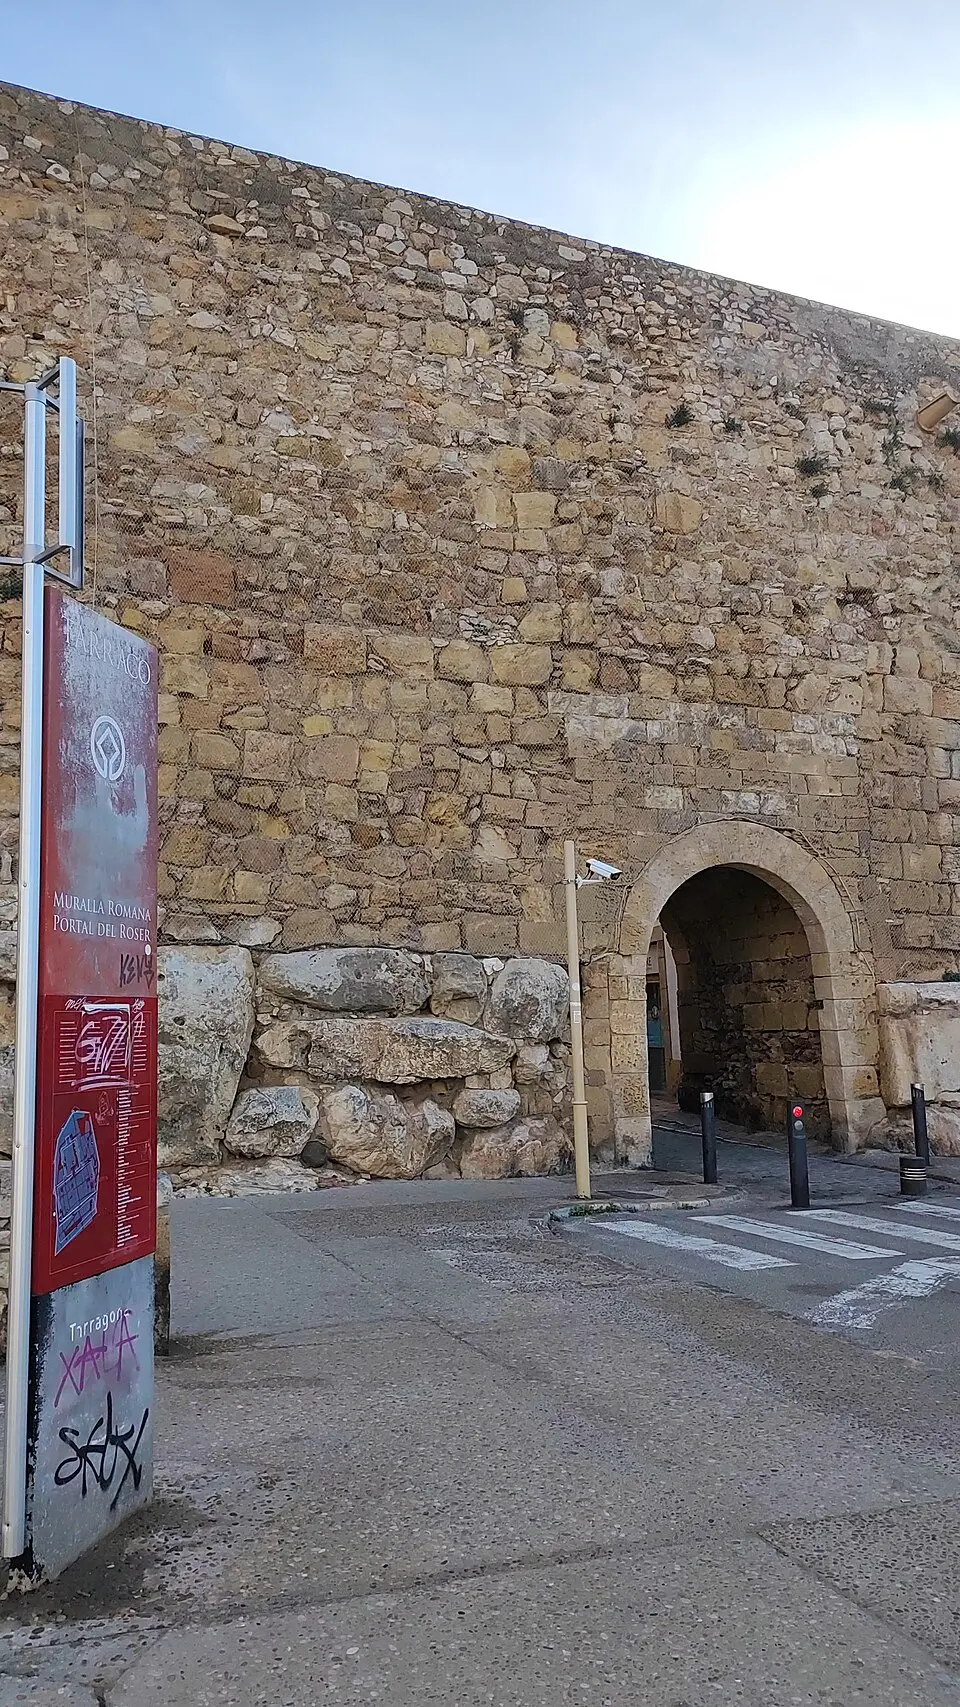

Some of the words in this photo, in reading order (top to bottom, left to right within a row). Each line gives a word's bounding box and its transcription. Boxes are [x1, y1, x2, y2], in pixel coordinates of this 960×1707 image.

[62, 614, 151, 685] TARRACO
[53, 891, 105, 915] MURALLA
[108, 900, 152, 922] ROMANA
[53, 914, 94, 936] PORTAL
[97, 922, 116, 938] DEL
[119, 923, 151, 942] ROSER
